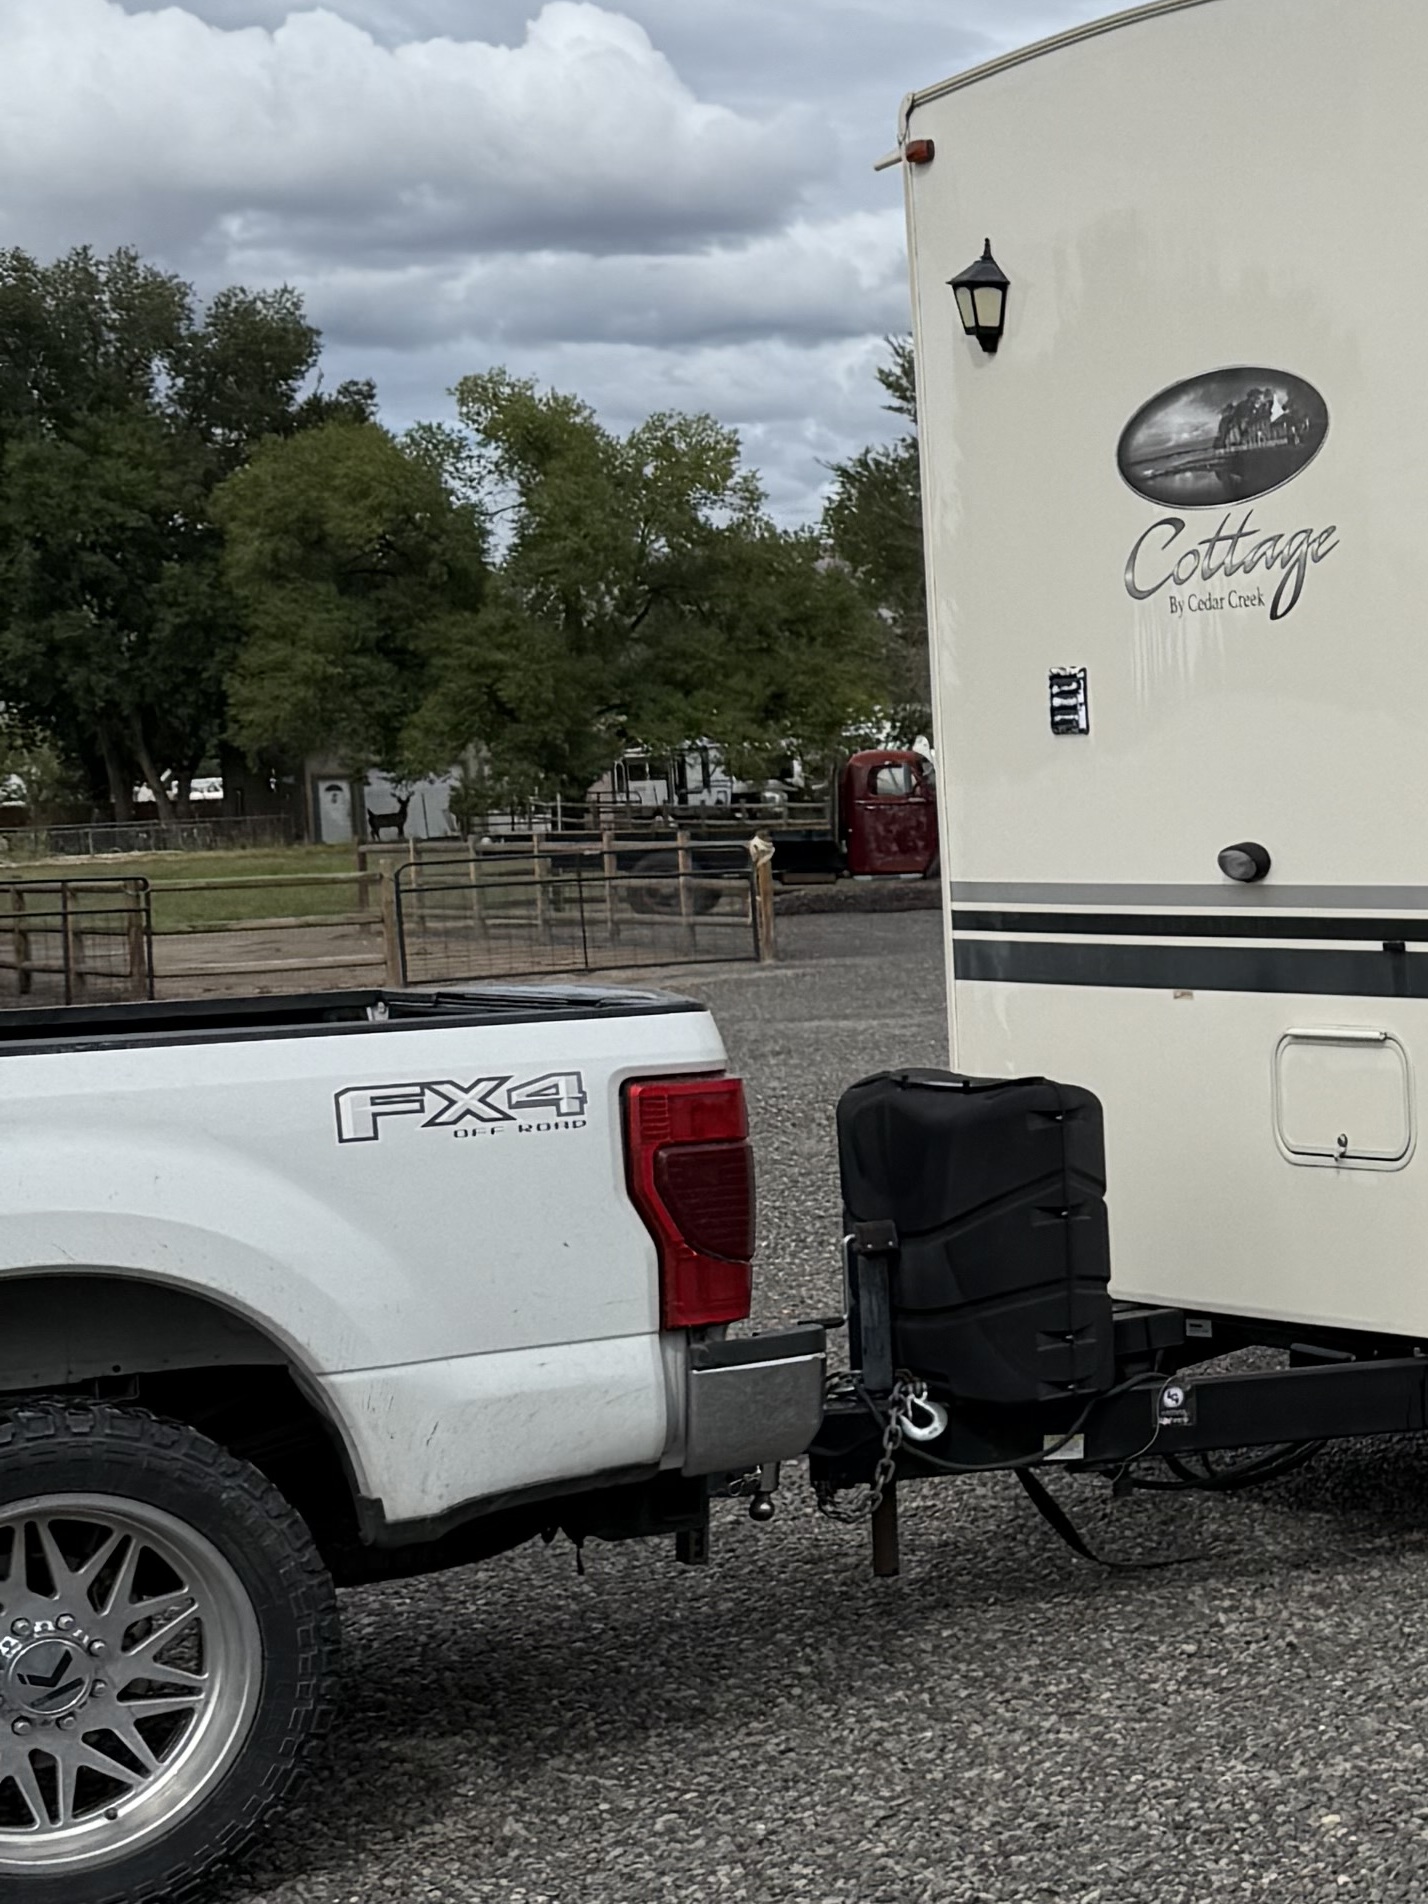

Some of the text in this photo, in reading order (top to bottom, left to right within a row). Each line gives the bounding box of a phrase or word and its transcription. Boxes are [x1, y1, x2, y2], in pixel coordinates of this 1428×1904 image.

[1124, 509, 1340, 621] Cottage
[1169, 586, 1265, 617] By Cedar Creek
[334, 1071, 588, 1143] FX4
[453, 1120, 587, 1138] OFF ROAD
